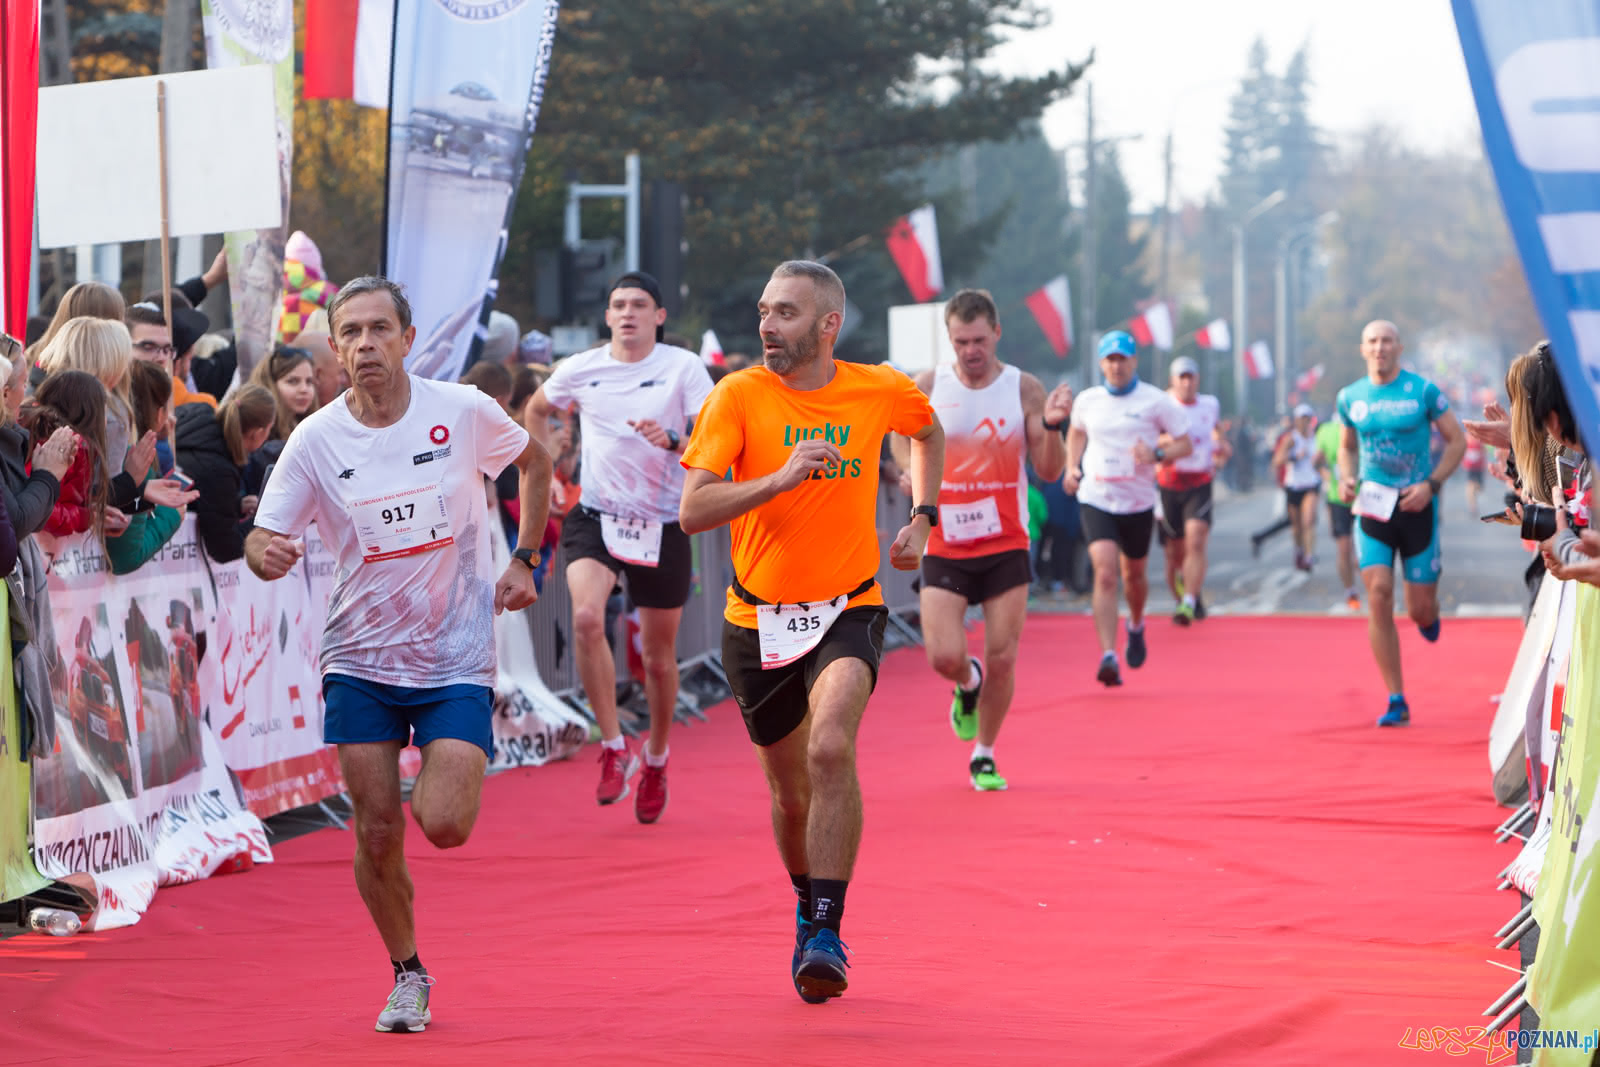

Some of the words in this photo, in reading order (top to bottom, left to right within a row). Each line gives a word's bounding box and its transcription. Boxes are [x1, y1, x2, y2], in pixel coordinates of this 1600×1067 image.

[784, 422, 850, 446] Lucky
[381, 503, 415, 525] 917
[955, 511, 984, 525] 1246
[395, 526, 412, 534] Adam
[617, 528, 640, 541] 864
[787, 615, 820, 632] 435
